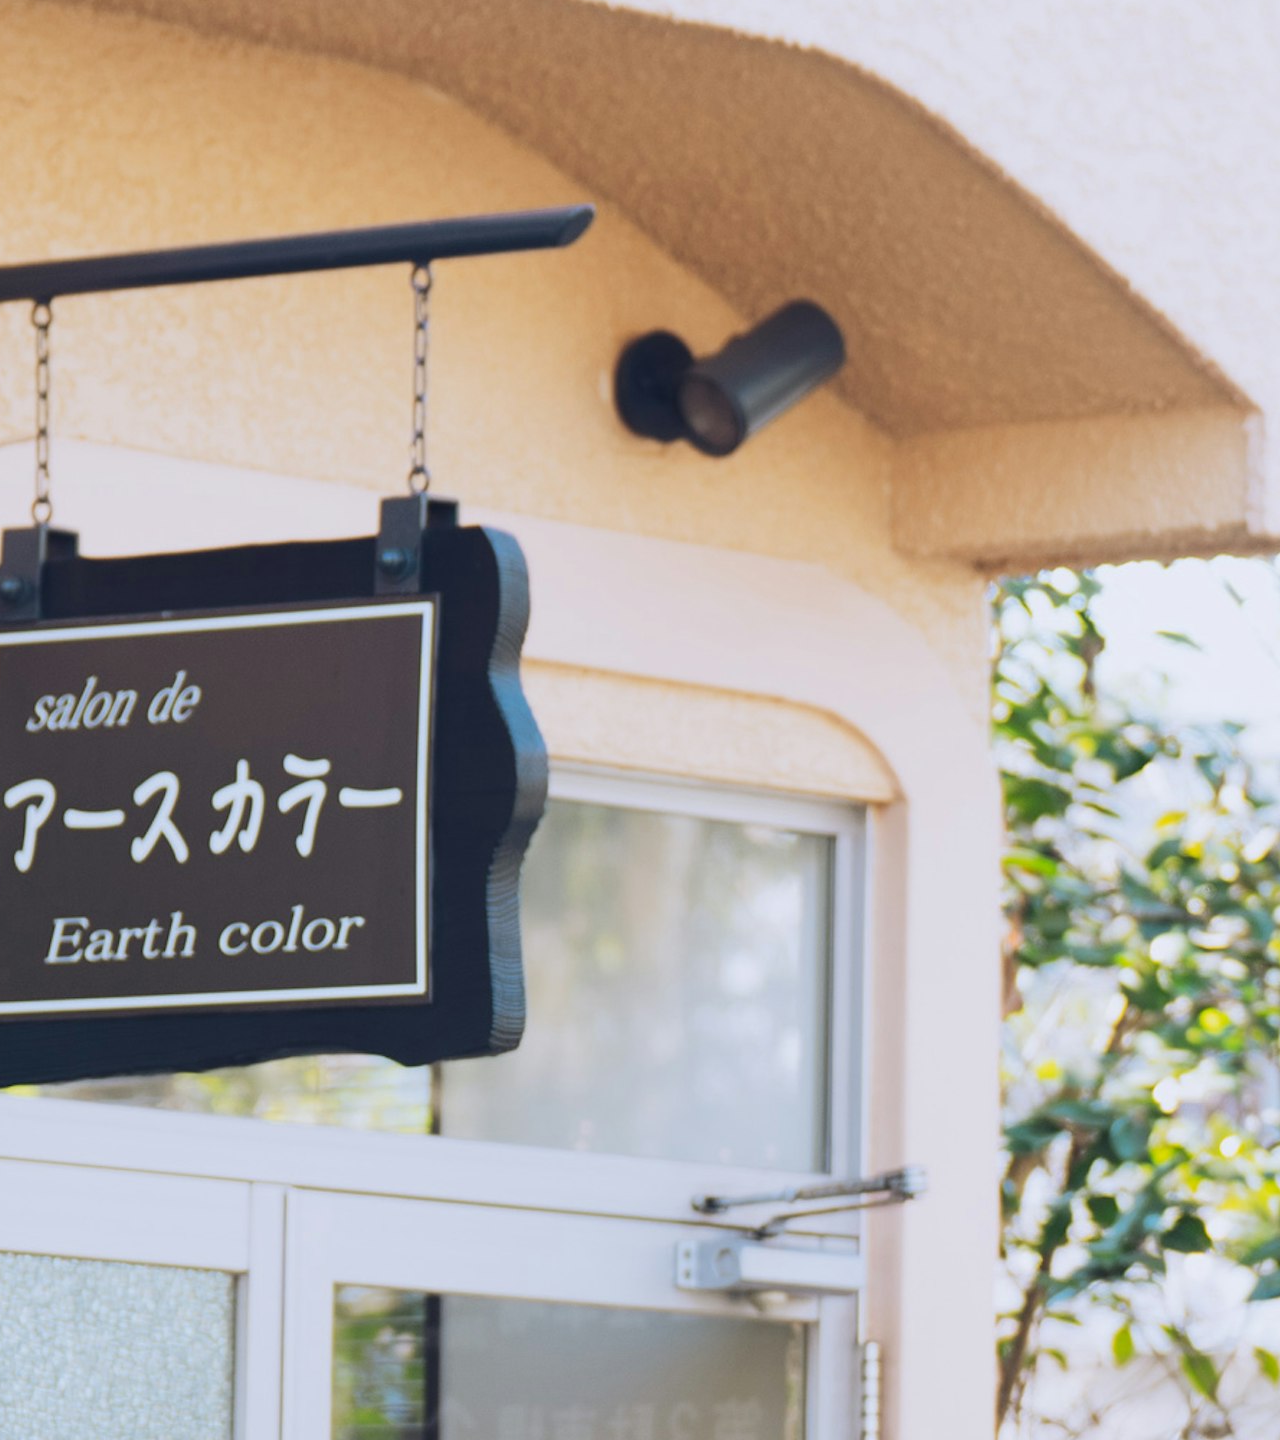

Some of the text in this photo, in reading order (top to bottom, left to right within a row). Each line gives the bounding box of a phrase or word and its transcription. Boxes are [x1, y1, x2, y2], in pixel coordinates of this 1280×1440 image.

[25, 669, 202, 732] salon de
[3, 753, 403, 872] アースカラー
[44, 904, 366, 964] Earth color
